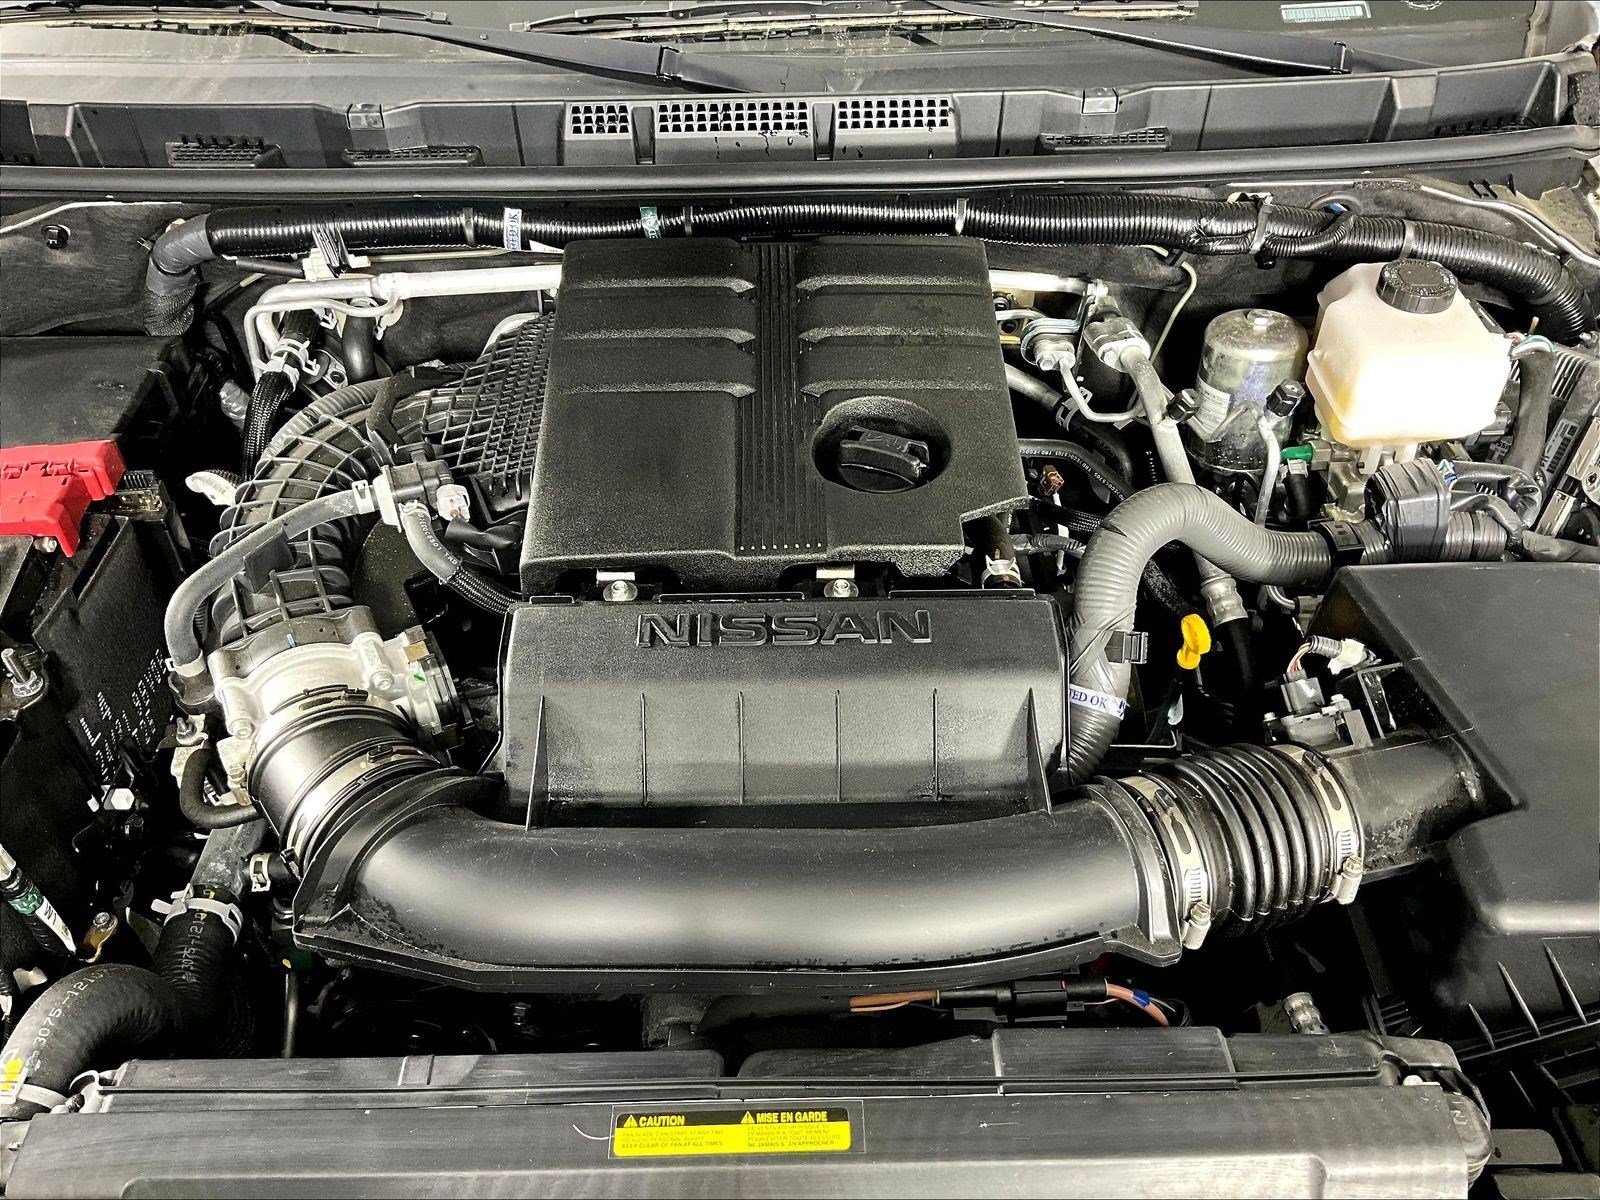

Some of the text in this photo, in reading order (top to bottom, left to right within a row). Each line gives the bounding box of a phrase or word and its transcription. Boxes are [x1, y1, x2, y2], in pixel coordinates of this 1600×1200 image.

[636, 609, 933, 647] NISSAN
[1090, 695, 1108, 709] OK
[639, 1115, 685, 1127] CAUTION
[756, 1111, 828, 1123] MISE EN GARDE
